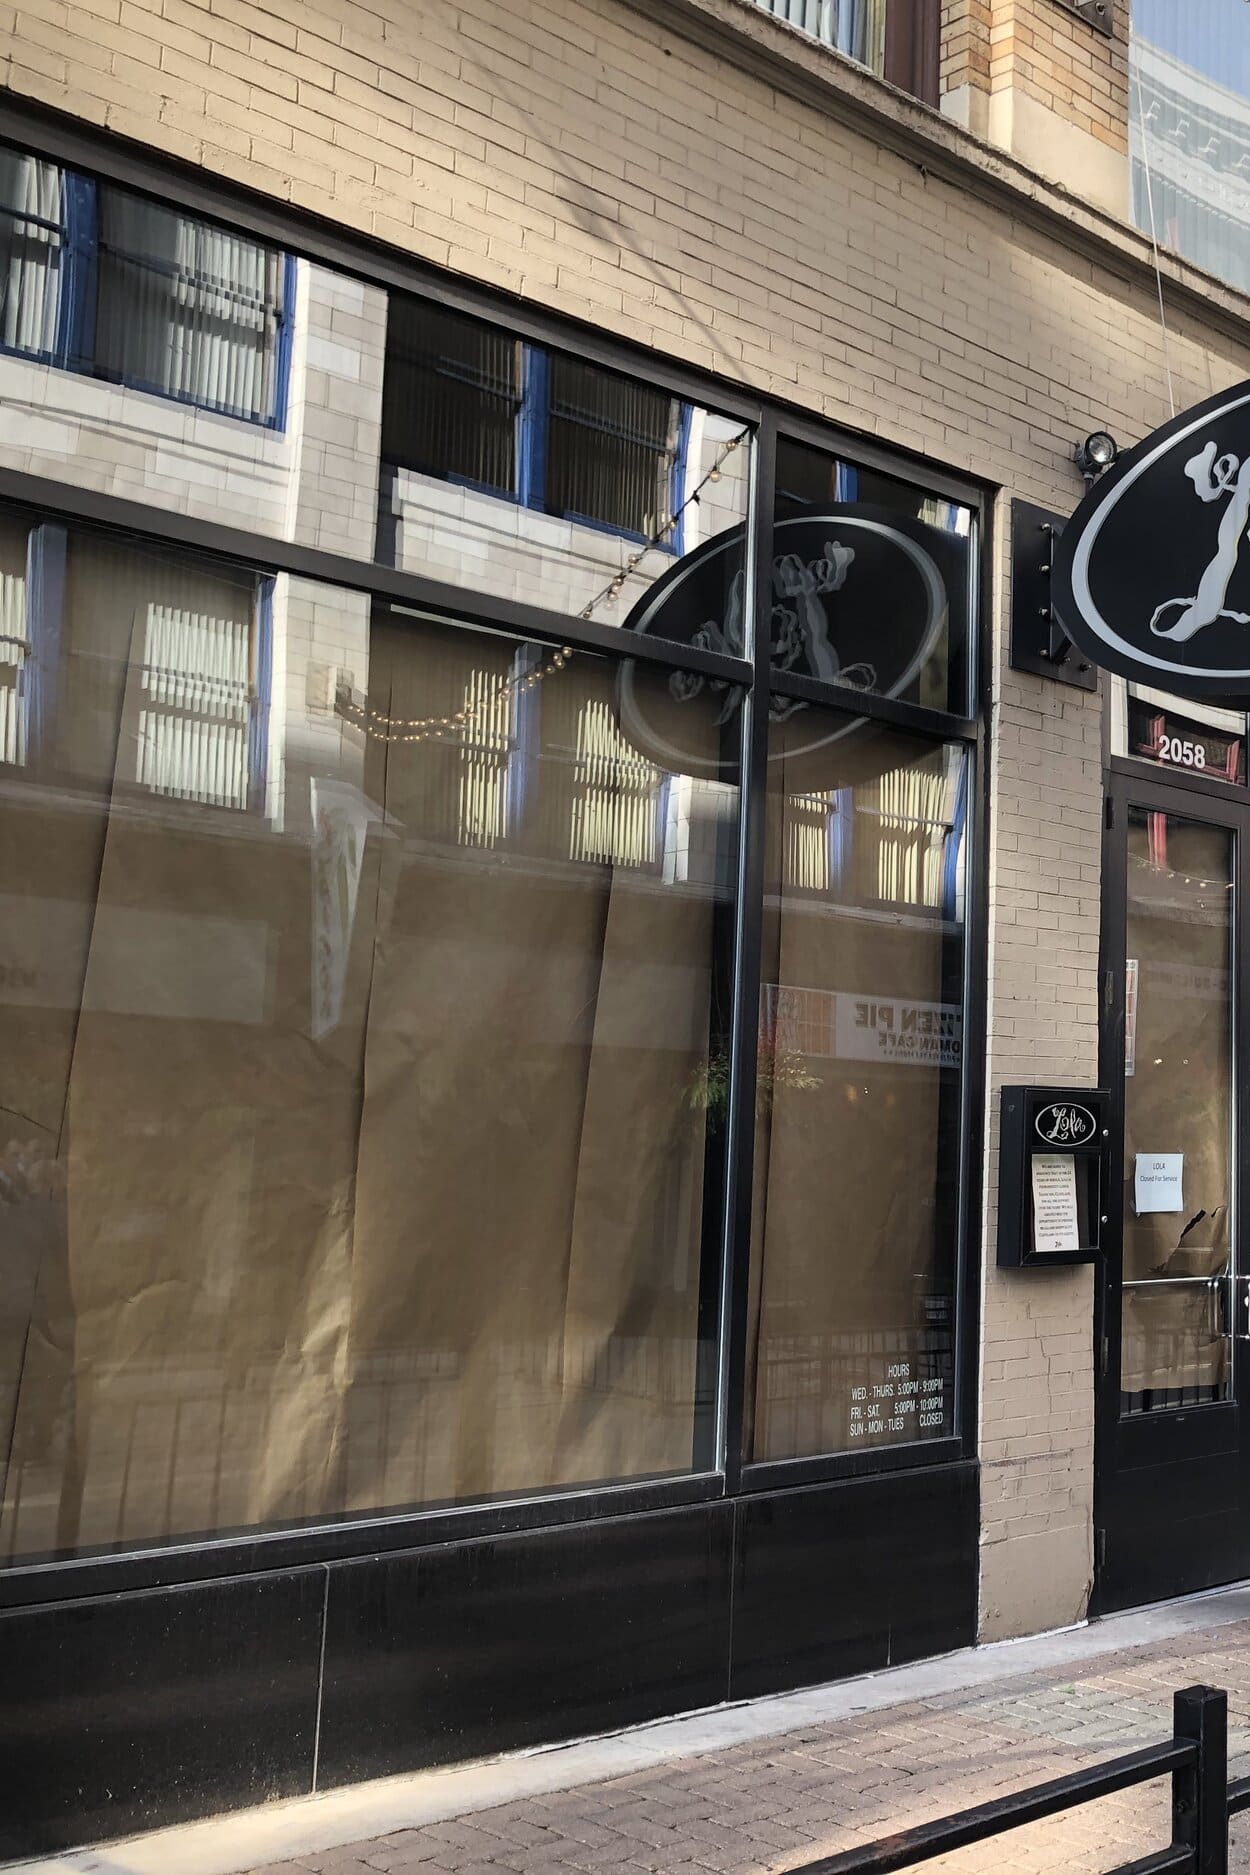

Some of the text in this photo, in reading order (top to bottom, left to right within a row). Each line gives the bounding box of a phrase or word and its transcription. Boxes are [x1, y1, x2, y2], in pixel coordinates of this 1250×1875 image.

[1158, 734, 1206, 769] 2058
[1046, 1107, 1087, 1140] Lola
[1152, 1162, 1166, 1170] LOLA
[888, 1363, 910, 1378] HOURS
[851, 1387, 868, 1401] WED.
[872, 1384, 895, 1399] THURS.
[897, 1381, 919, 1396] 5:00PM
[922, 1378, 944, 1393] 9:00PM
[894, 1400, 916, 1415] 5:00PM
[920, 1396, 944, 1411] 10:00PM
[850, 1423, 864, 1437] SUN
[868, 1420, 884, 1434] MON
[888, 1417, 905, 1431] TUES
[919, 1412, 944, 1427] CLOSED
